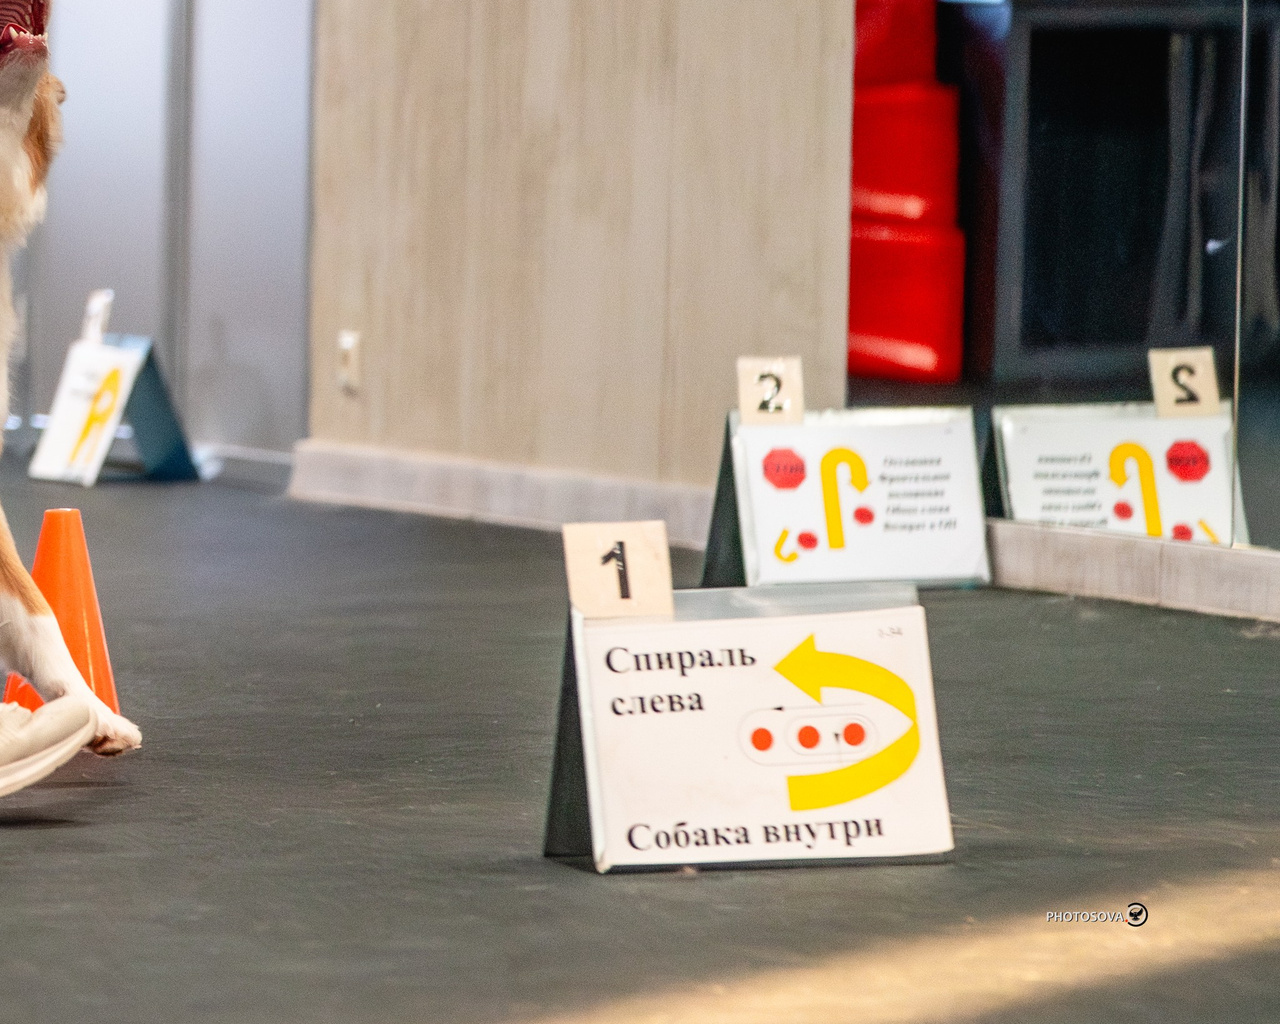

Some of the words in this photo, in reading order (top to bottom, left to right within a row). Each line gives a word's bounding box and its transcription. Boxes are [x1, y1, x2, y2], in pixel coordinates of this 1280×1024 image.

[756, 372, 784, 412] 2
[601, 540, 632, 600] 1
[605, 645, 757, 676] Спираль
[610, 692, 704, 716] слева
[627, 821, 751, 851] Собака
[763, 818, 884, 849] внутри
